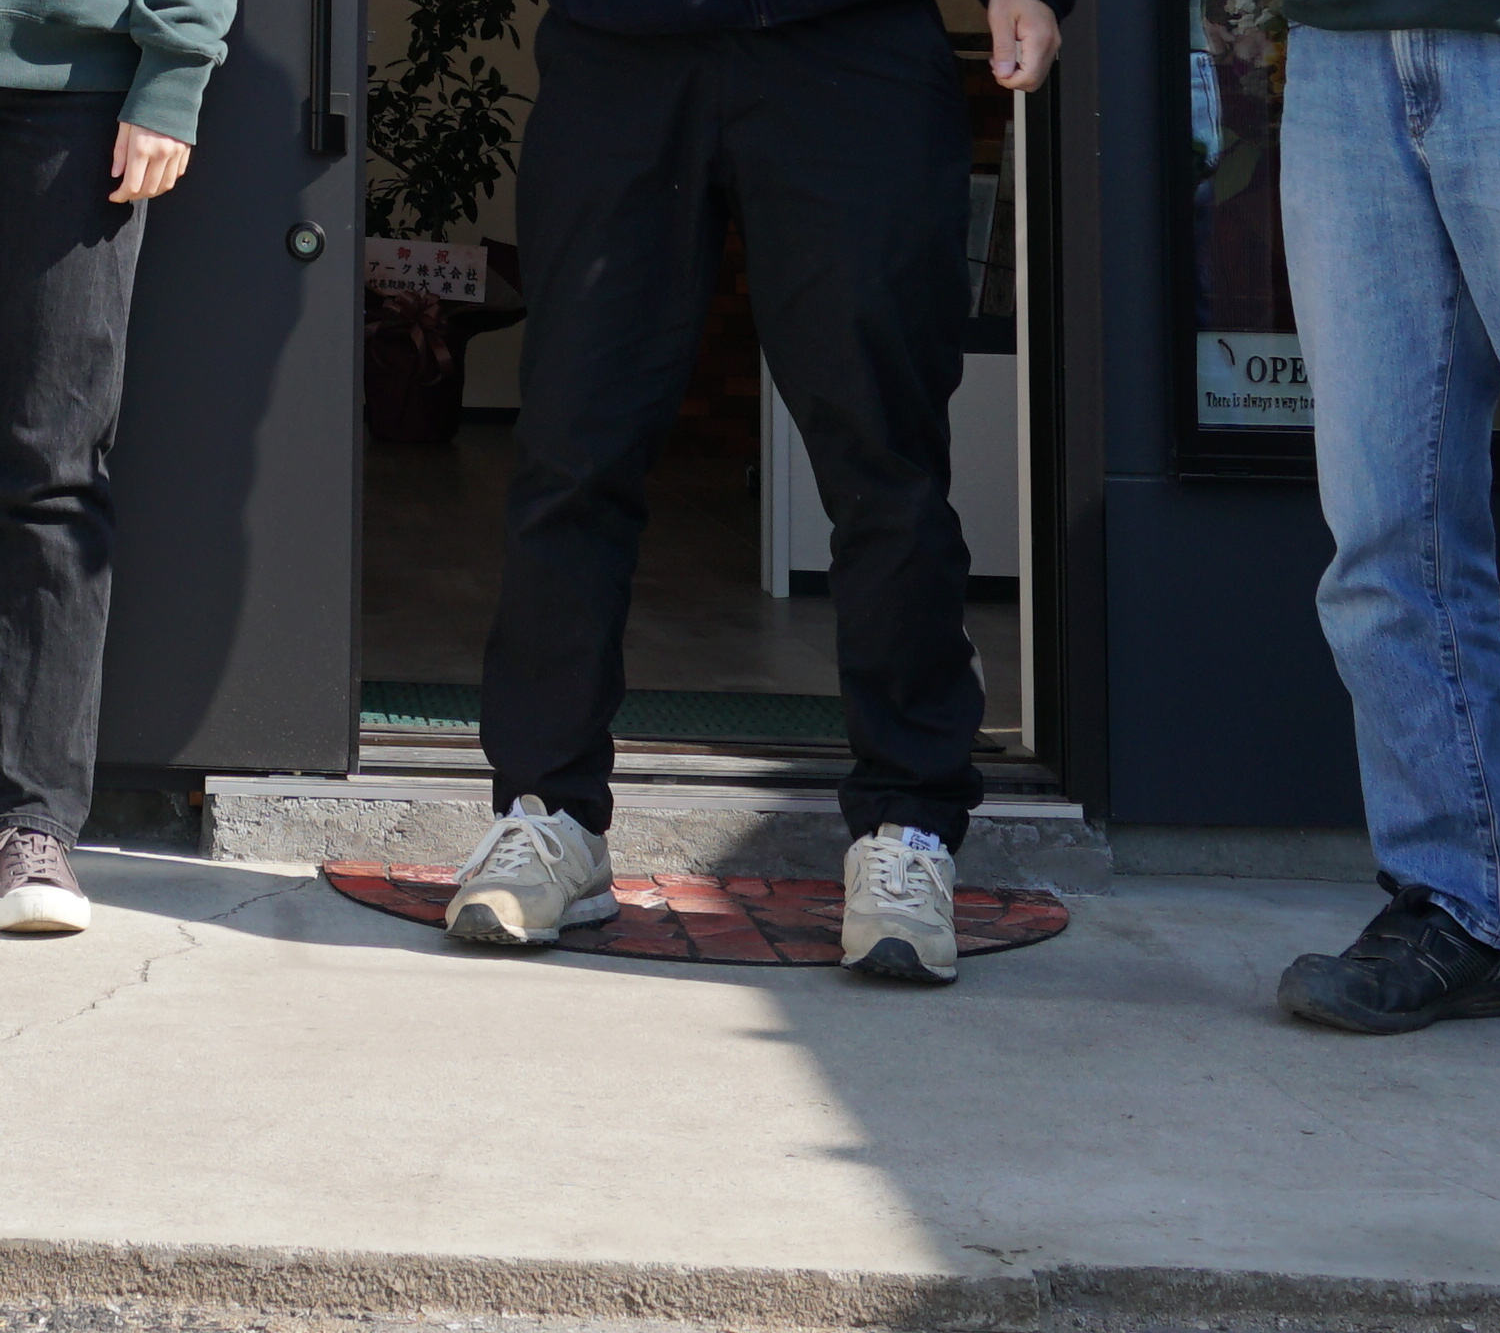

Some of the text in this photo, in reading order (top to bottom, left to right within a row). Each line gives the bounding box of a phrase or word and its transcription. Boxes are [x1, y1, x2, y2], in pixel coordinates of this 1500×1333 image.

[368, 261, 479, 282] アーク株式会社
[1246, 355, 1308, 384] OPE
[1205, 391, 1231, 408] There
[1232, 392, 1241, 408] is
[1243, 393, 1273, 412] always
[1281, 396, 1299, 413] way
[1300, 395, 1309, 409] to
